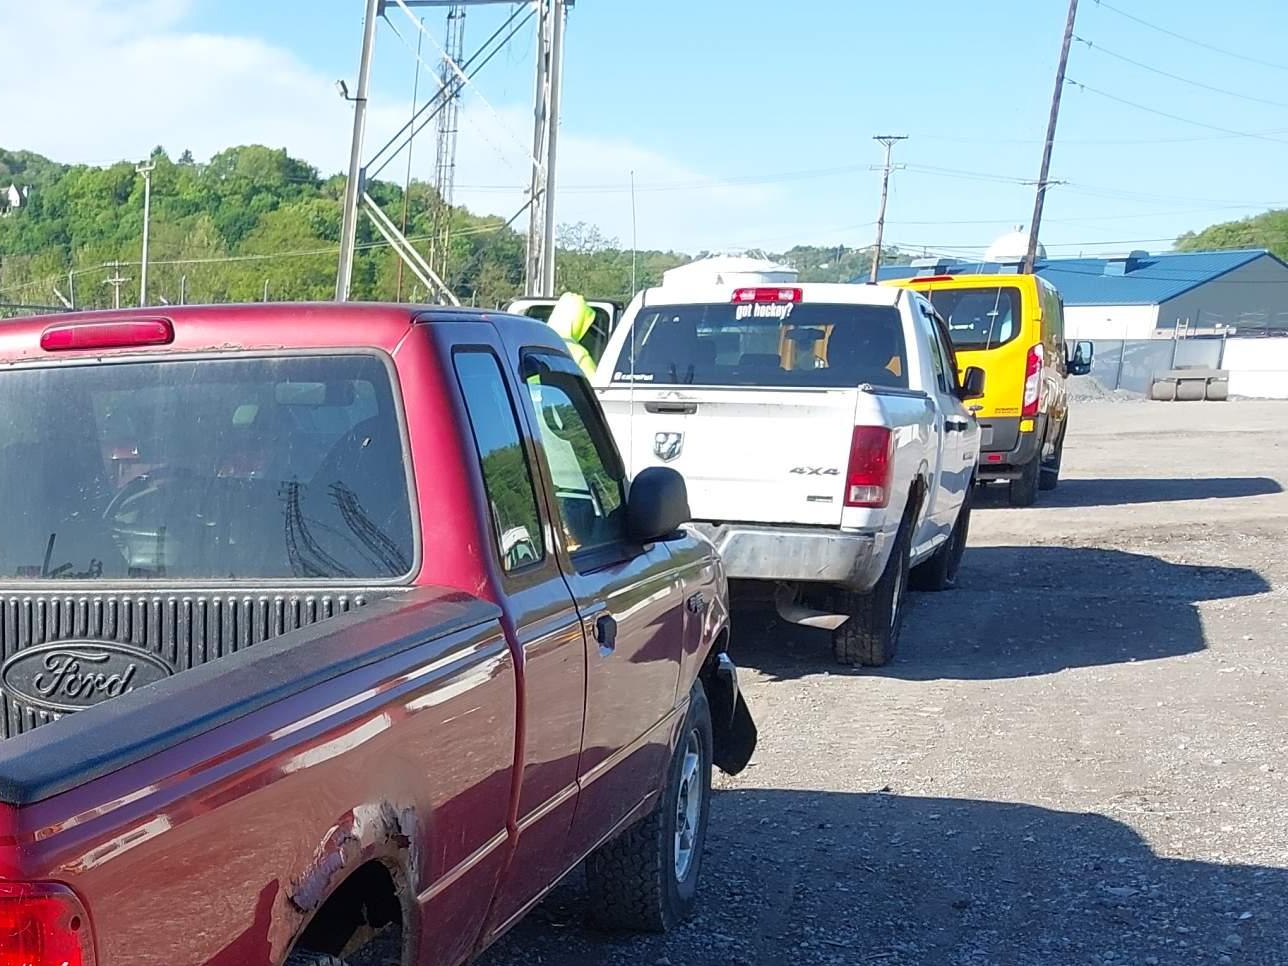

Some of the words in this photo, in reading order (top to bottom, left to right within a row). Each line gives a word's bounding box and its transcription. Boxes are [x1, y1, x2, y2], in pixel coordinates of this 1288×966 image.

[735, 303, 753, 320] got
[753, 301, 794, 320] hockey?
[33, 651, 137, 698] Ford
